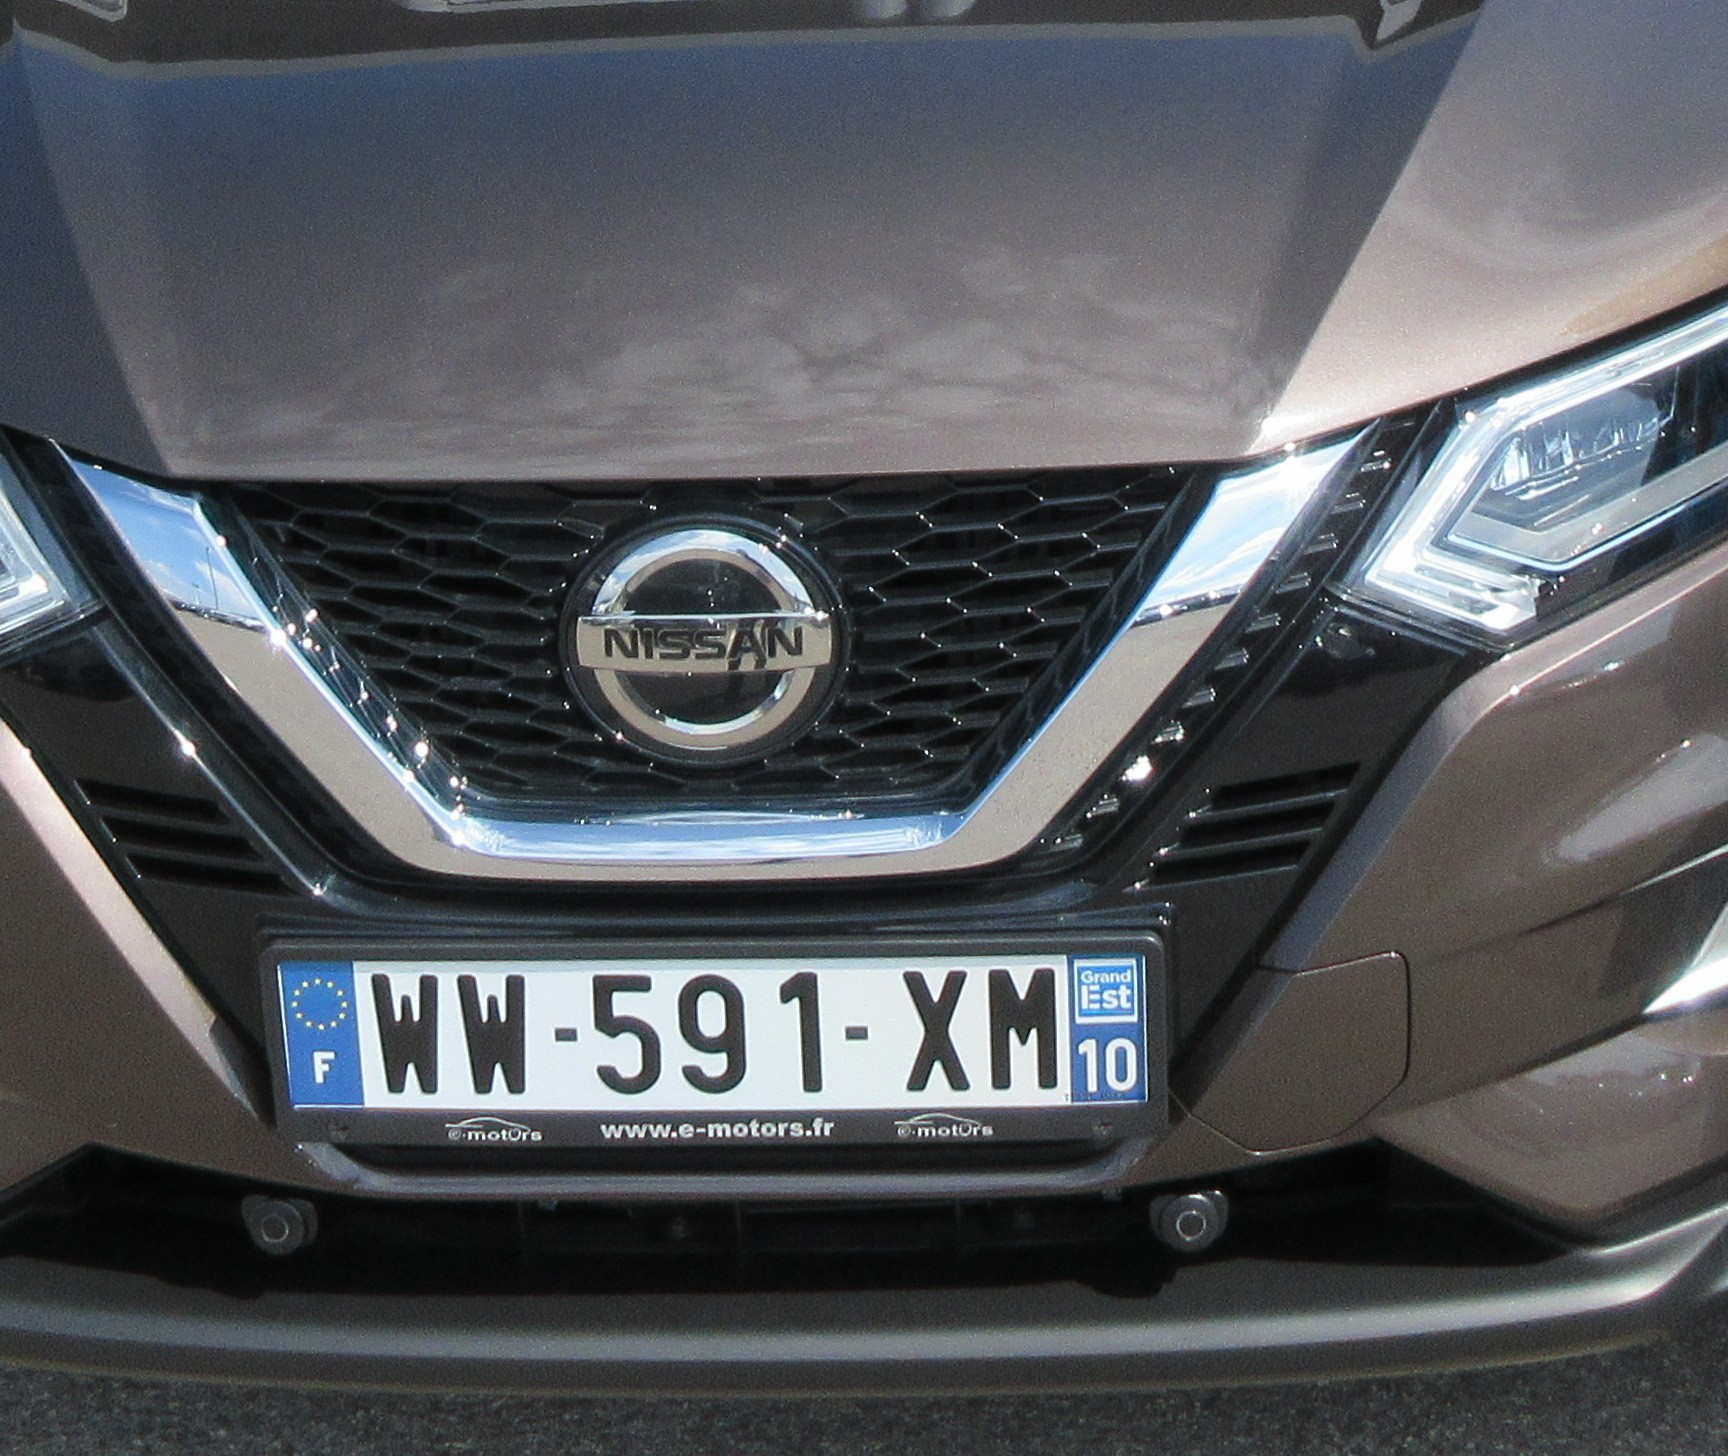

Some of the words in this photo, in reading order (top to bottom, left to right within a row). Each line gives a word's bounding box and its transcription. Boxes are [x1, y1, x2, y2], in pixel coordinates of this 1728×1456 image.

[604, 626, 804, 661] NISSAN
[1080, 969, 1132, 984] Grand
[1080, 984, 1132, 1010] Est
[371, 968, 1058, 1095] WW-591-XM
[313, 1051, 336, 1084] F
[1078, 1037, 1138, 1094] 10
[599, 1117, 835, 1139] www.e-motors.fr
